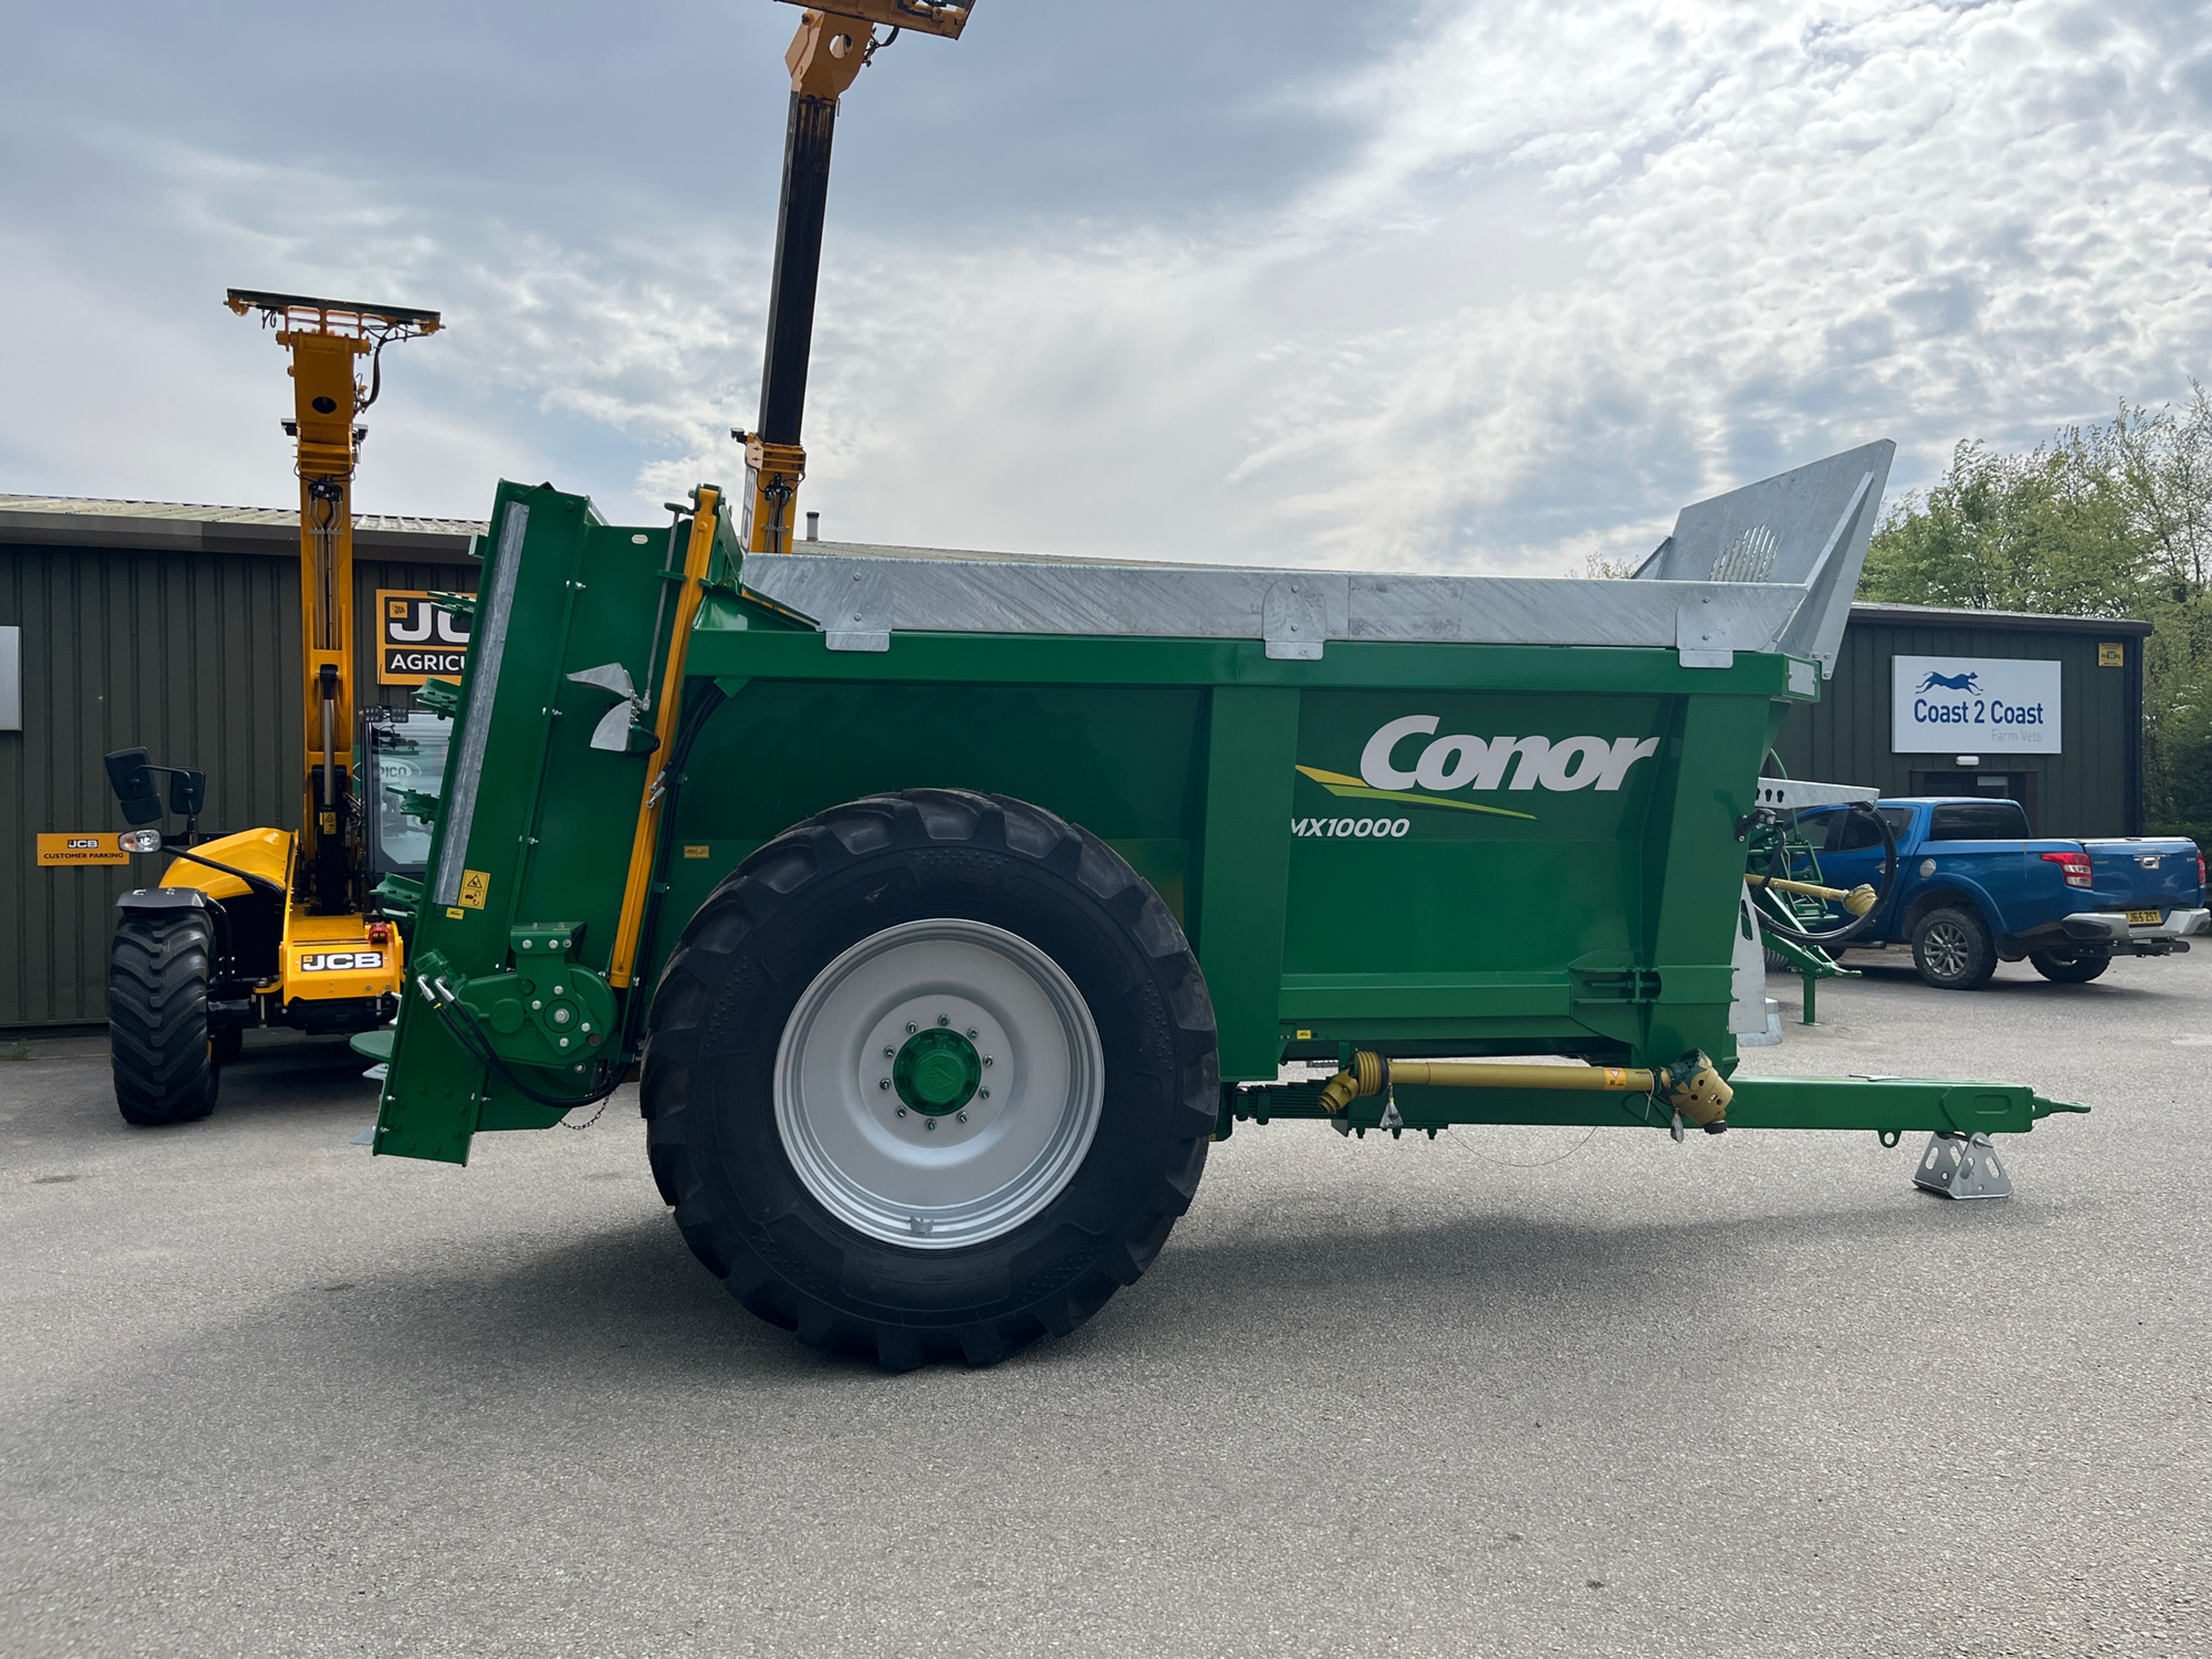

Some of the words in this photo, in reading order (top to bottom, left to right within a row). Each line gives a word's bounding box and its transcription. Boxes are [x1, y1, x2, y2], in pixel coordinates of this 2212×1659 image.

[390, 602, 471, 643] JC
[1914, 698, 1968, 723] Coast
[1974, 699, 1985, 724] 2
[1991, 700, 2044, 724] Coast
[1991, 729, 2018, 741] Farm
[2021, 730, 2041, 742] Vets
[1360, 714, 1660, 792] Conor
[1291, 818, 1410, 837] MX10000
[68, 840, 98, 848] JCB
[303, 953, 381, 970] JCB
